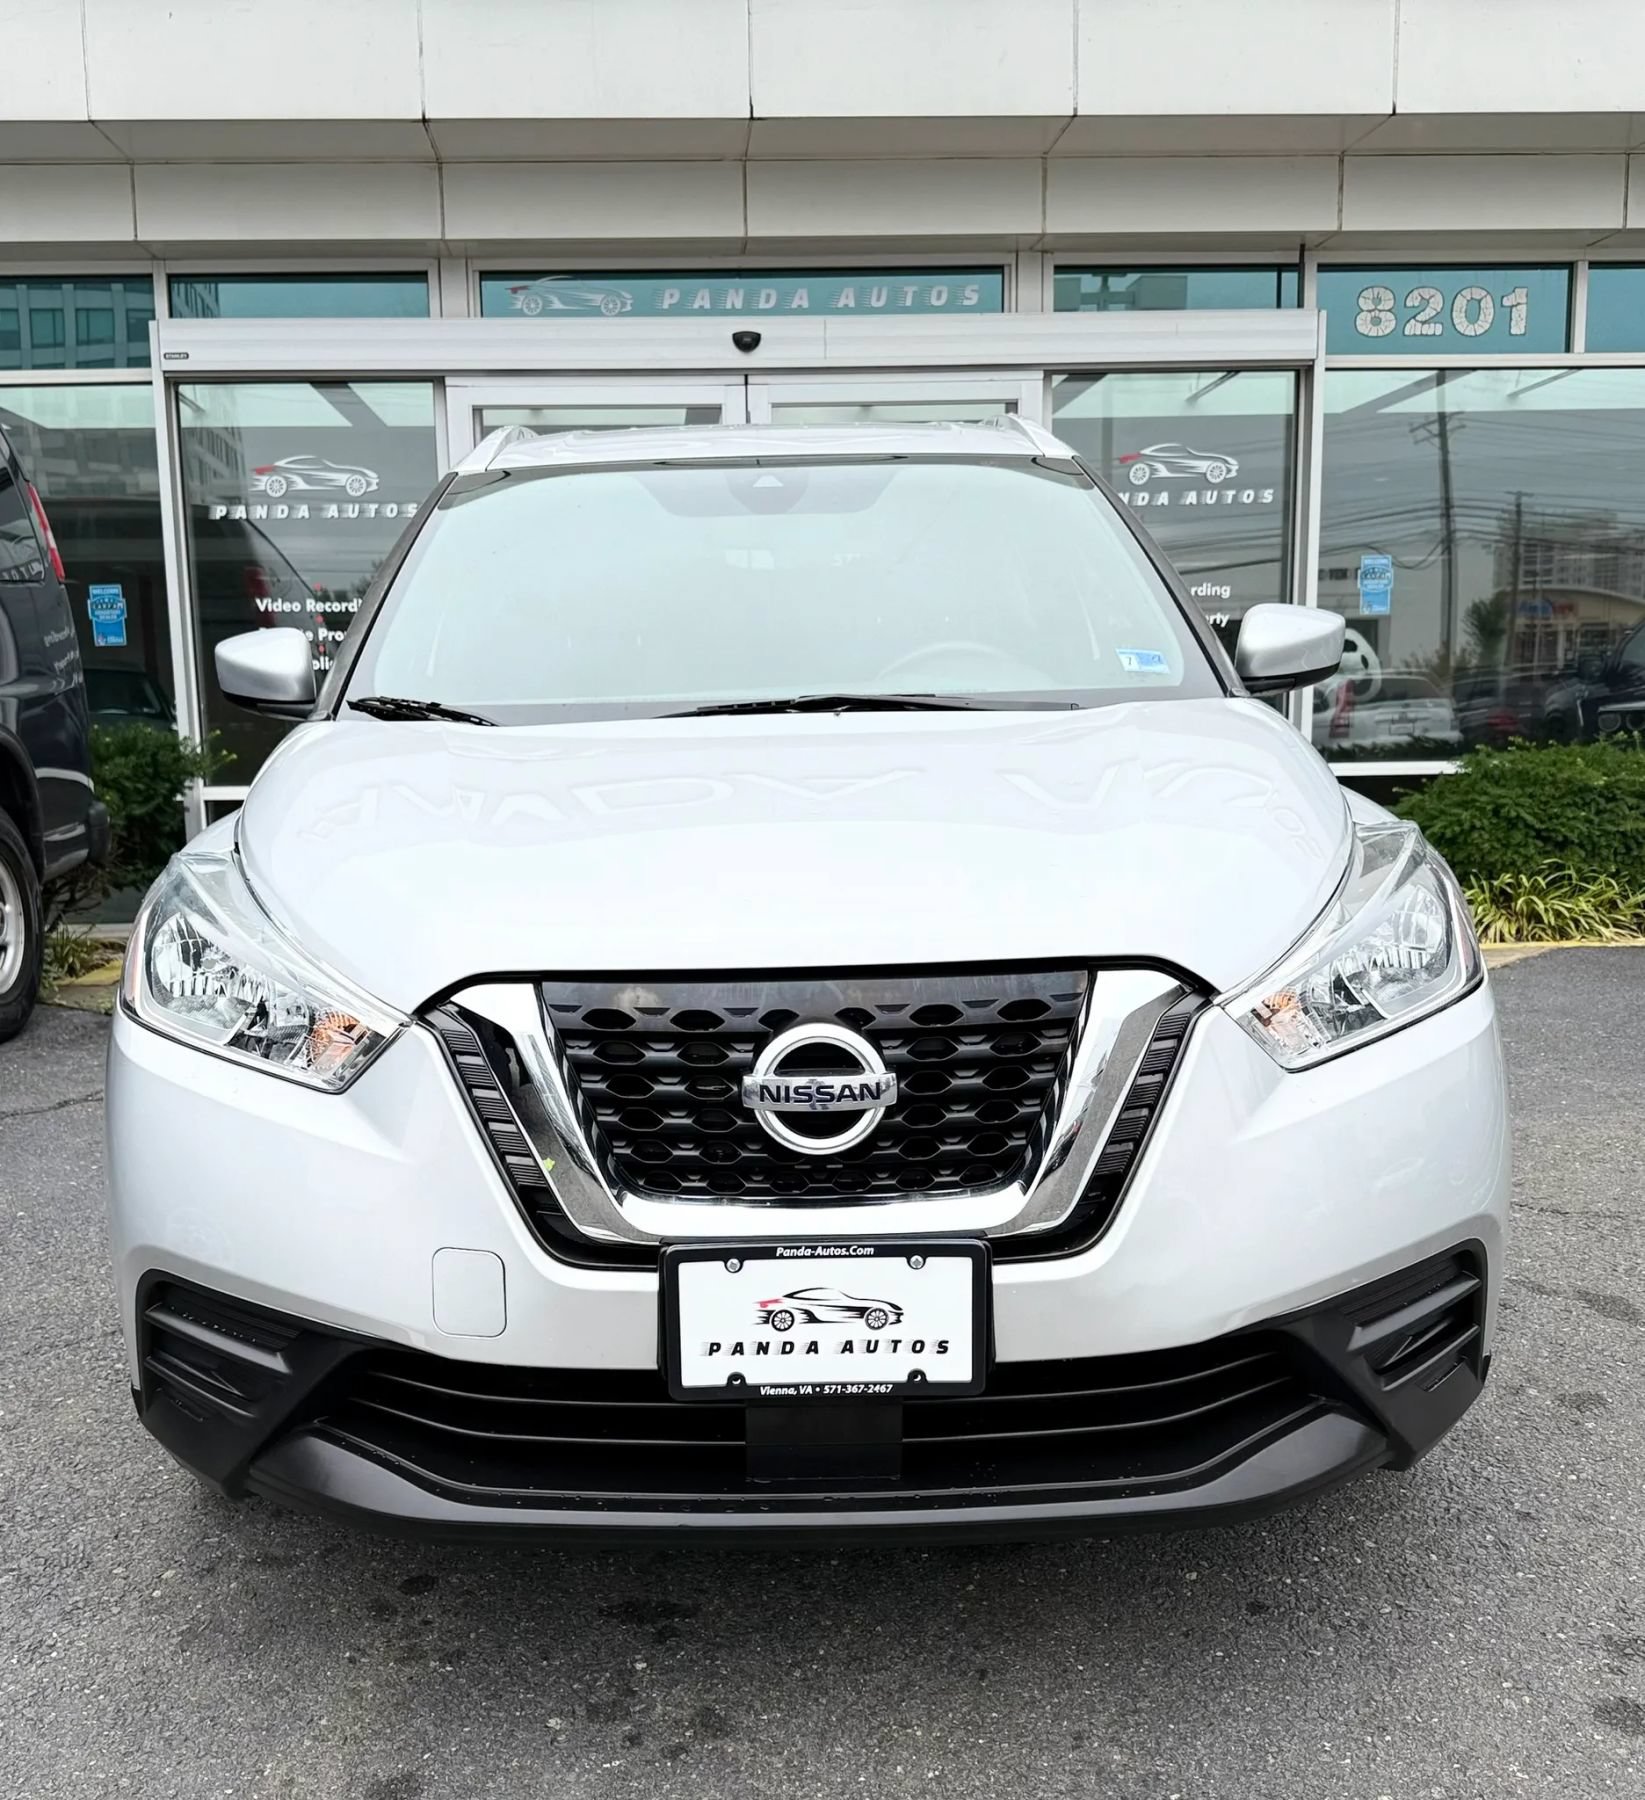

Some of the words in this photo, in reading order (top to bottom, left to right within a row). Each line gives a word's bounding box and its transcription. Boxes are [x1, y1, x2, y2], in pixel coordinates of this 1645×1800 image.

[657, 288, 809, 310] PANDA
[832, 285, 979, 308] AUTOS
[1354, 285, 1529, 338] 8201
[1117, 491, 1170, 507] NDA
[1181, 489, 1275, 505] AUTOS
[209, 503, 310, 520] PANDA
[321, 503, 418, 519] AUTOS
[255, 598, 301, 613] Video
[306, 597, 362, 613] Record
[758, 1081, 882, 1106] NISSAN
[776, 1245, 875, 1257] Panda-Autos.Com
[702, 1341, 820, 1356] PANDA
[838, 1339, 950, 1355] AUTOS
[760, 1385, 798, 1395] Vienna,
[799, 1385, 813, 1394] VA
[823, 1384, 893, 1394] 571-367-2467
